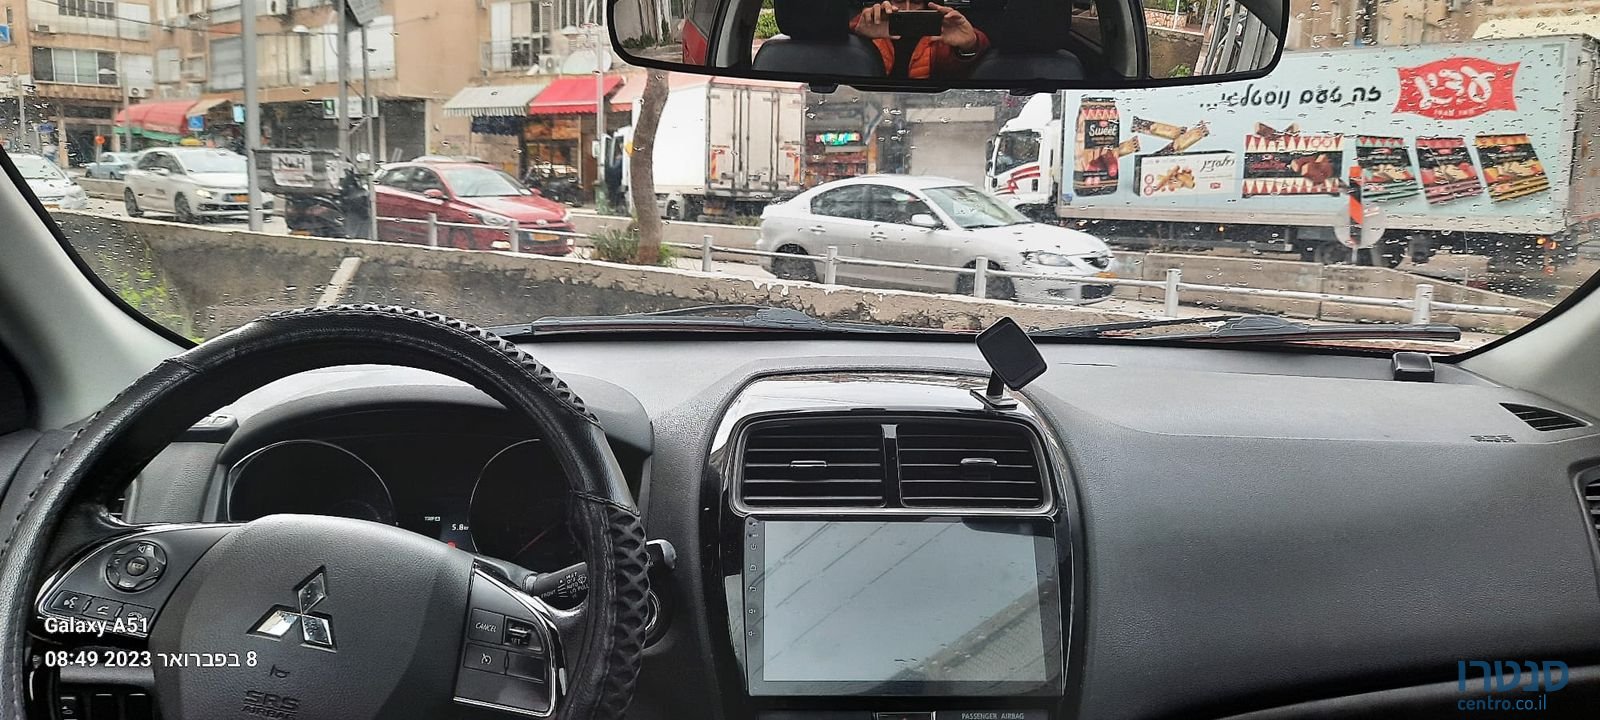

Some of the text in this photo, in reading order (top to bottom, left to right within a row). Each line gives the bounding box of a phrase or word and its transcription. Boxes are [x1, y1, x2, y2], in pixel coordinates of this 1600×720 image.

[1299, 85, 1343, 105] טעם
[1352, 85, 1382, 103] זה
[1088, 123, 1118, 137] Sweet
[476, 622, 497, 633] CANCEL
[244, 690, 301, 710] SRS
[961, 712, 1025, 720] PASSENGER AIRBAG
